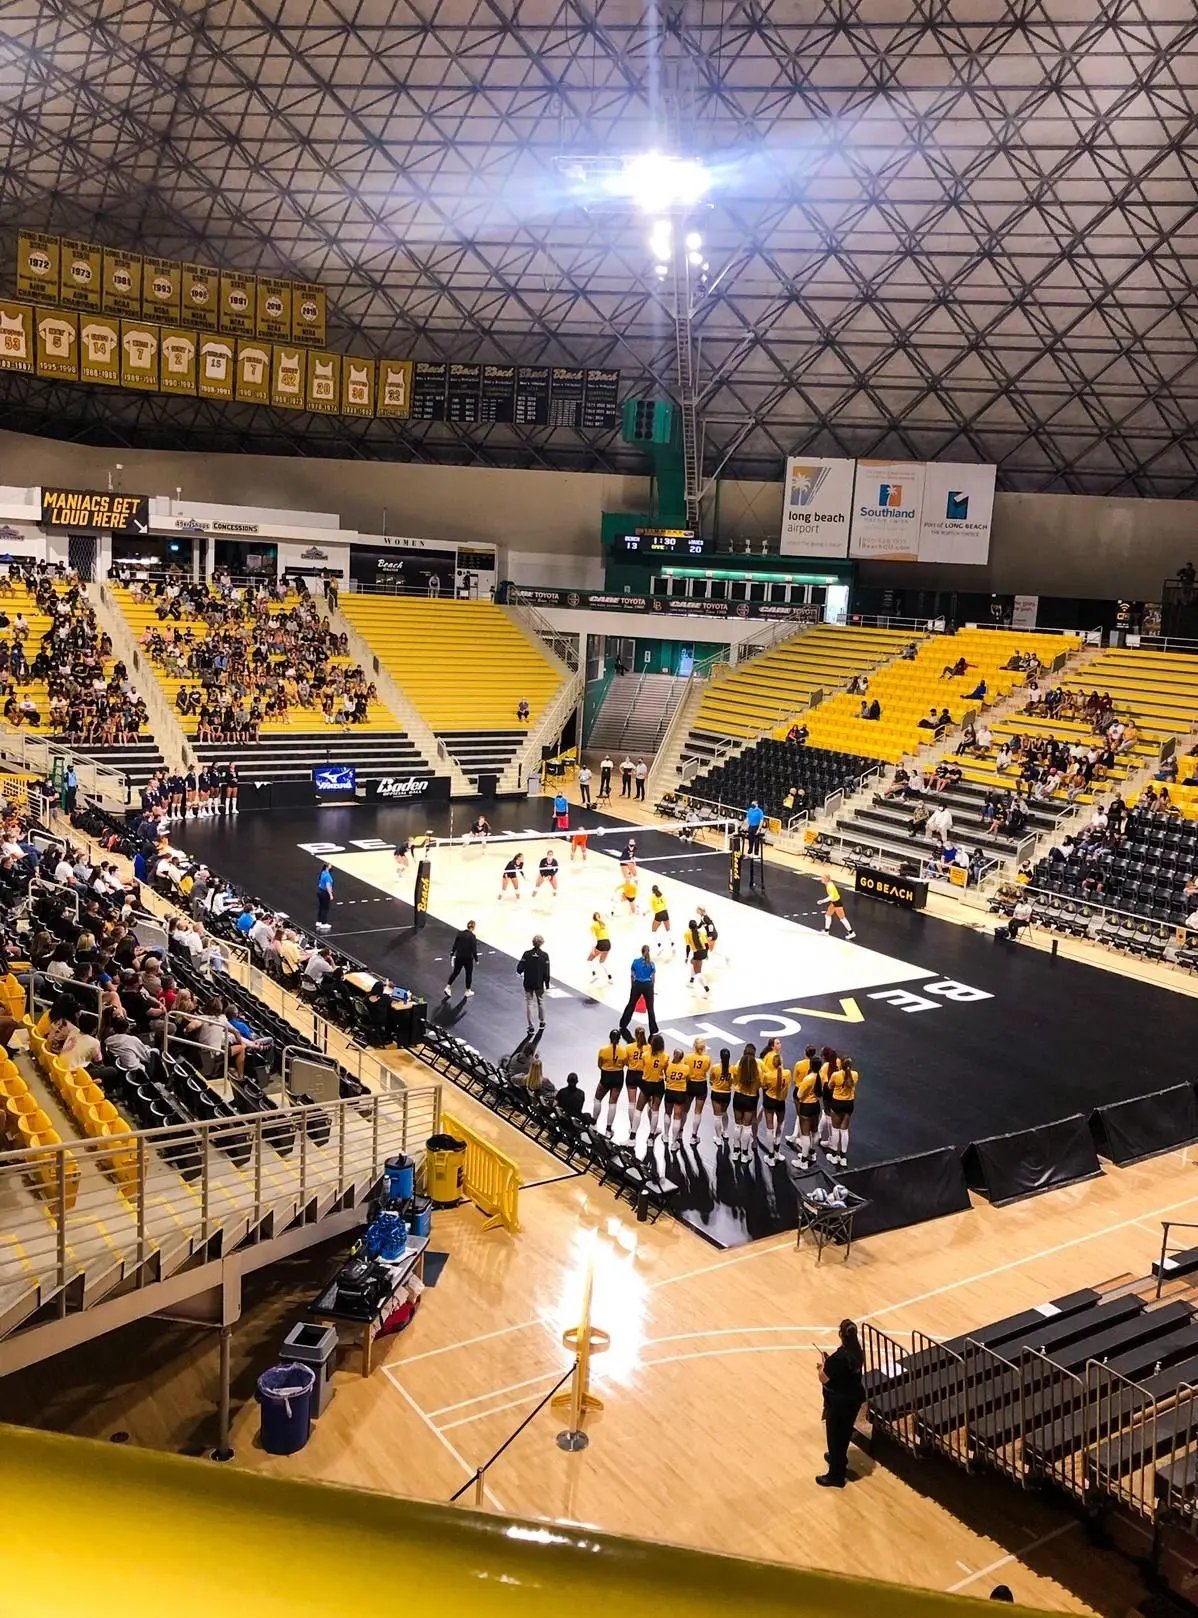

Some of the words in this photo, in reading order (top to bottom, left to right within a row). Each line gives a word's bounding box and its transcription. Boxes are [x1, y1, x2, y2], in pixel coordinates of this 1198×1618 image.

[30, 258, 50, 269] 1972
[72, 267, 90, 278] 1973
[0, 360, 30, 370] 83-1987
[211, 360, 221, 368] 15
[282, 374, 296, 386] 42
[316, 382, 330, 395] 20
[44, 492, 109, 512] MANIACS
[114, 498, 140, 513] GET
[788, 512, 810, 523] long
[814, 513, 844, 522] beach
[861, 507, 915, 518] Southland
[52, 510, 89, 526] LOUD
[93, 512, 129, 528] HERE
[213, 522, 258, 532] CONCESSIONS
[788, 524, 819, 533] airport
[384, 538, 425, 546] WOMEN
[654, 537, 676, 545] 1:30
[378, 559, 404, 568] Beach
[377, 777, 428, 793] Baden
[417, 877, 429, 912] Beach
[860, 877, 874, 888] GO
[876, 883, 913, 901] BEACH
[662, 979, 995, 1048] BEACH
[654, 1060, 659, 1068] 6
[694, 1060, 703, 1069] 13
[671, 1072, 683, 1080] 23
